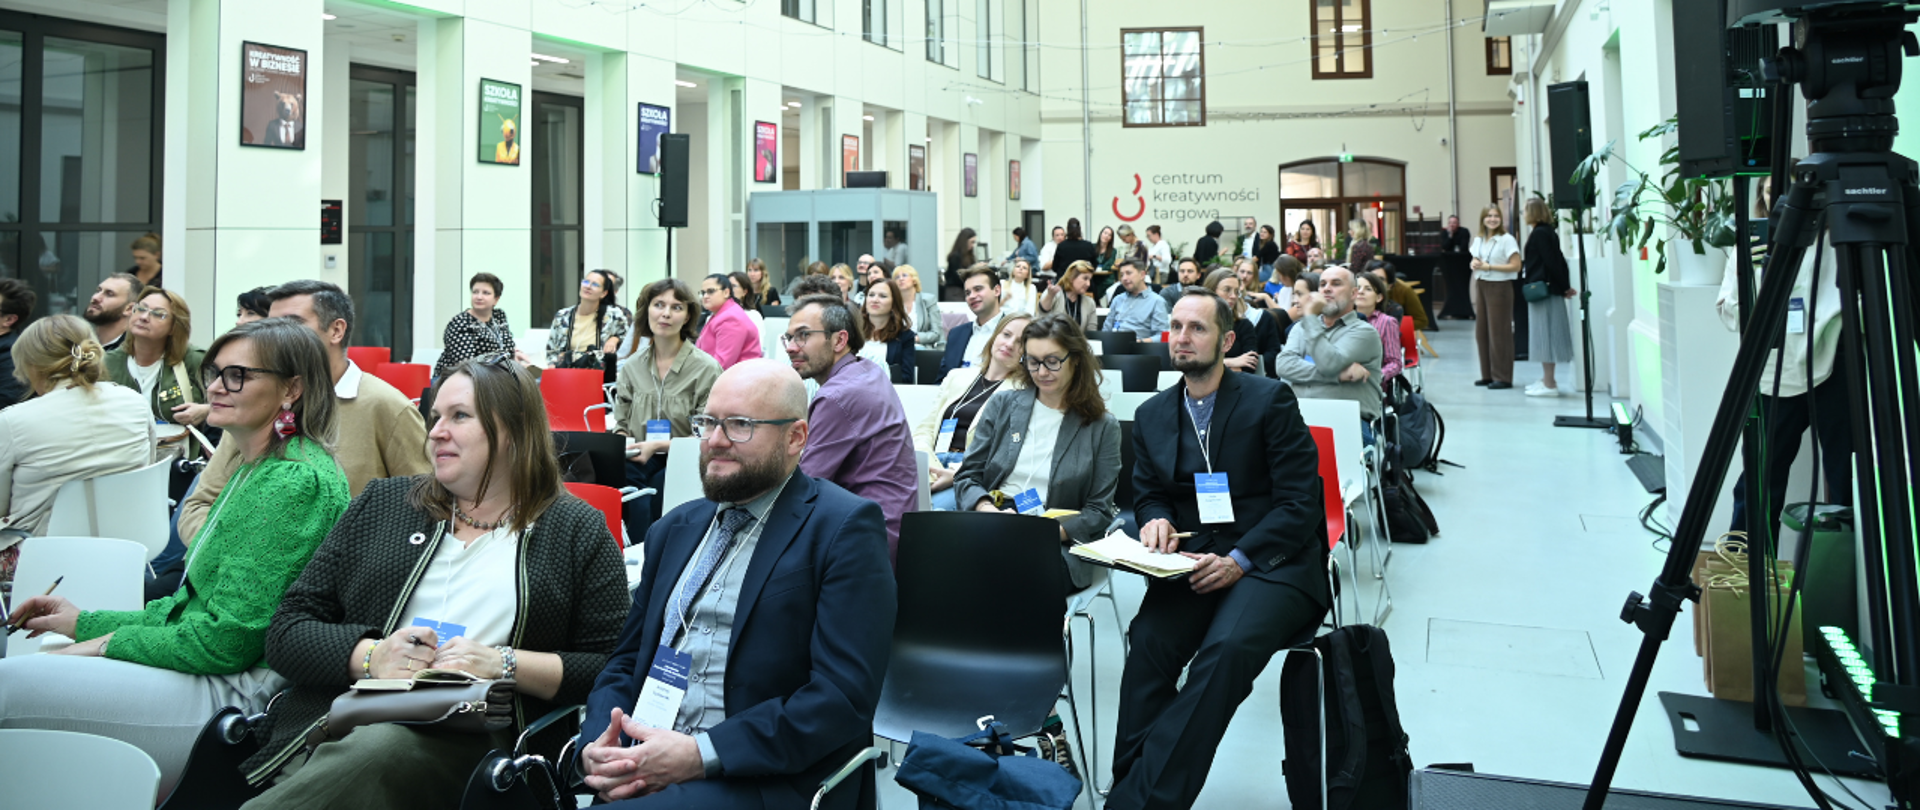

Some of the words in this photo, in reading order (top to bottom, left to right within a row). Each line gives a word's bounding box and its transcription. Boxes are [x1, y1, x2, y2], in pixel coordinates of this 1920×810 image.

[249, 57, 260, 68] W
[261, 60, 301, 73] BIZNESIE
[484, 84, 519, 100] SZKOŁA
[640, 107, 668, 121] SZKOŁA
[1152, 173, 1223, 185] centrum
[1153, 188, 1260, 205] kreatywności
[1844, 187, 1887, 195] sachtler
[1153, 208, 1220, 223] targowa
